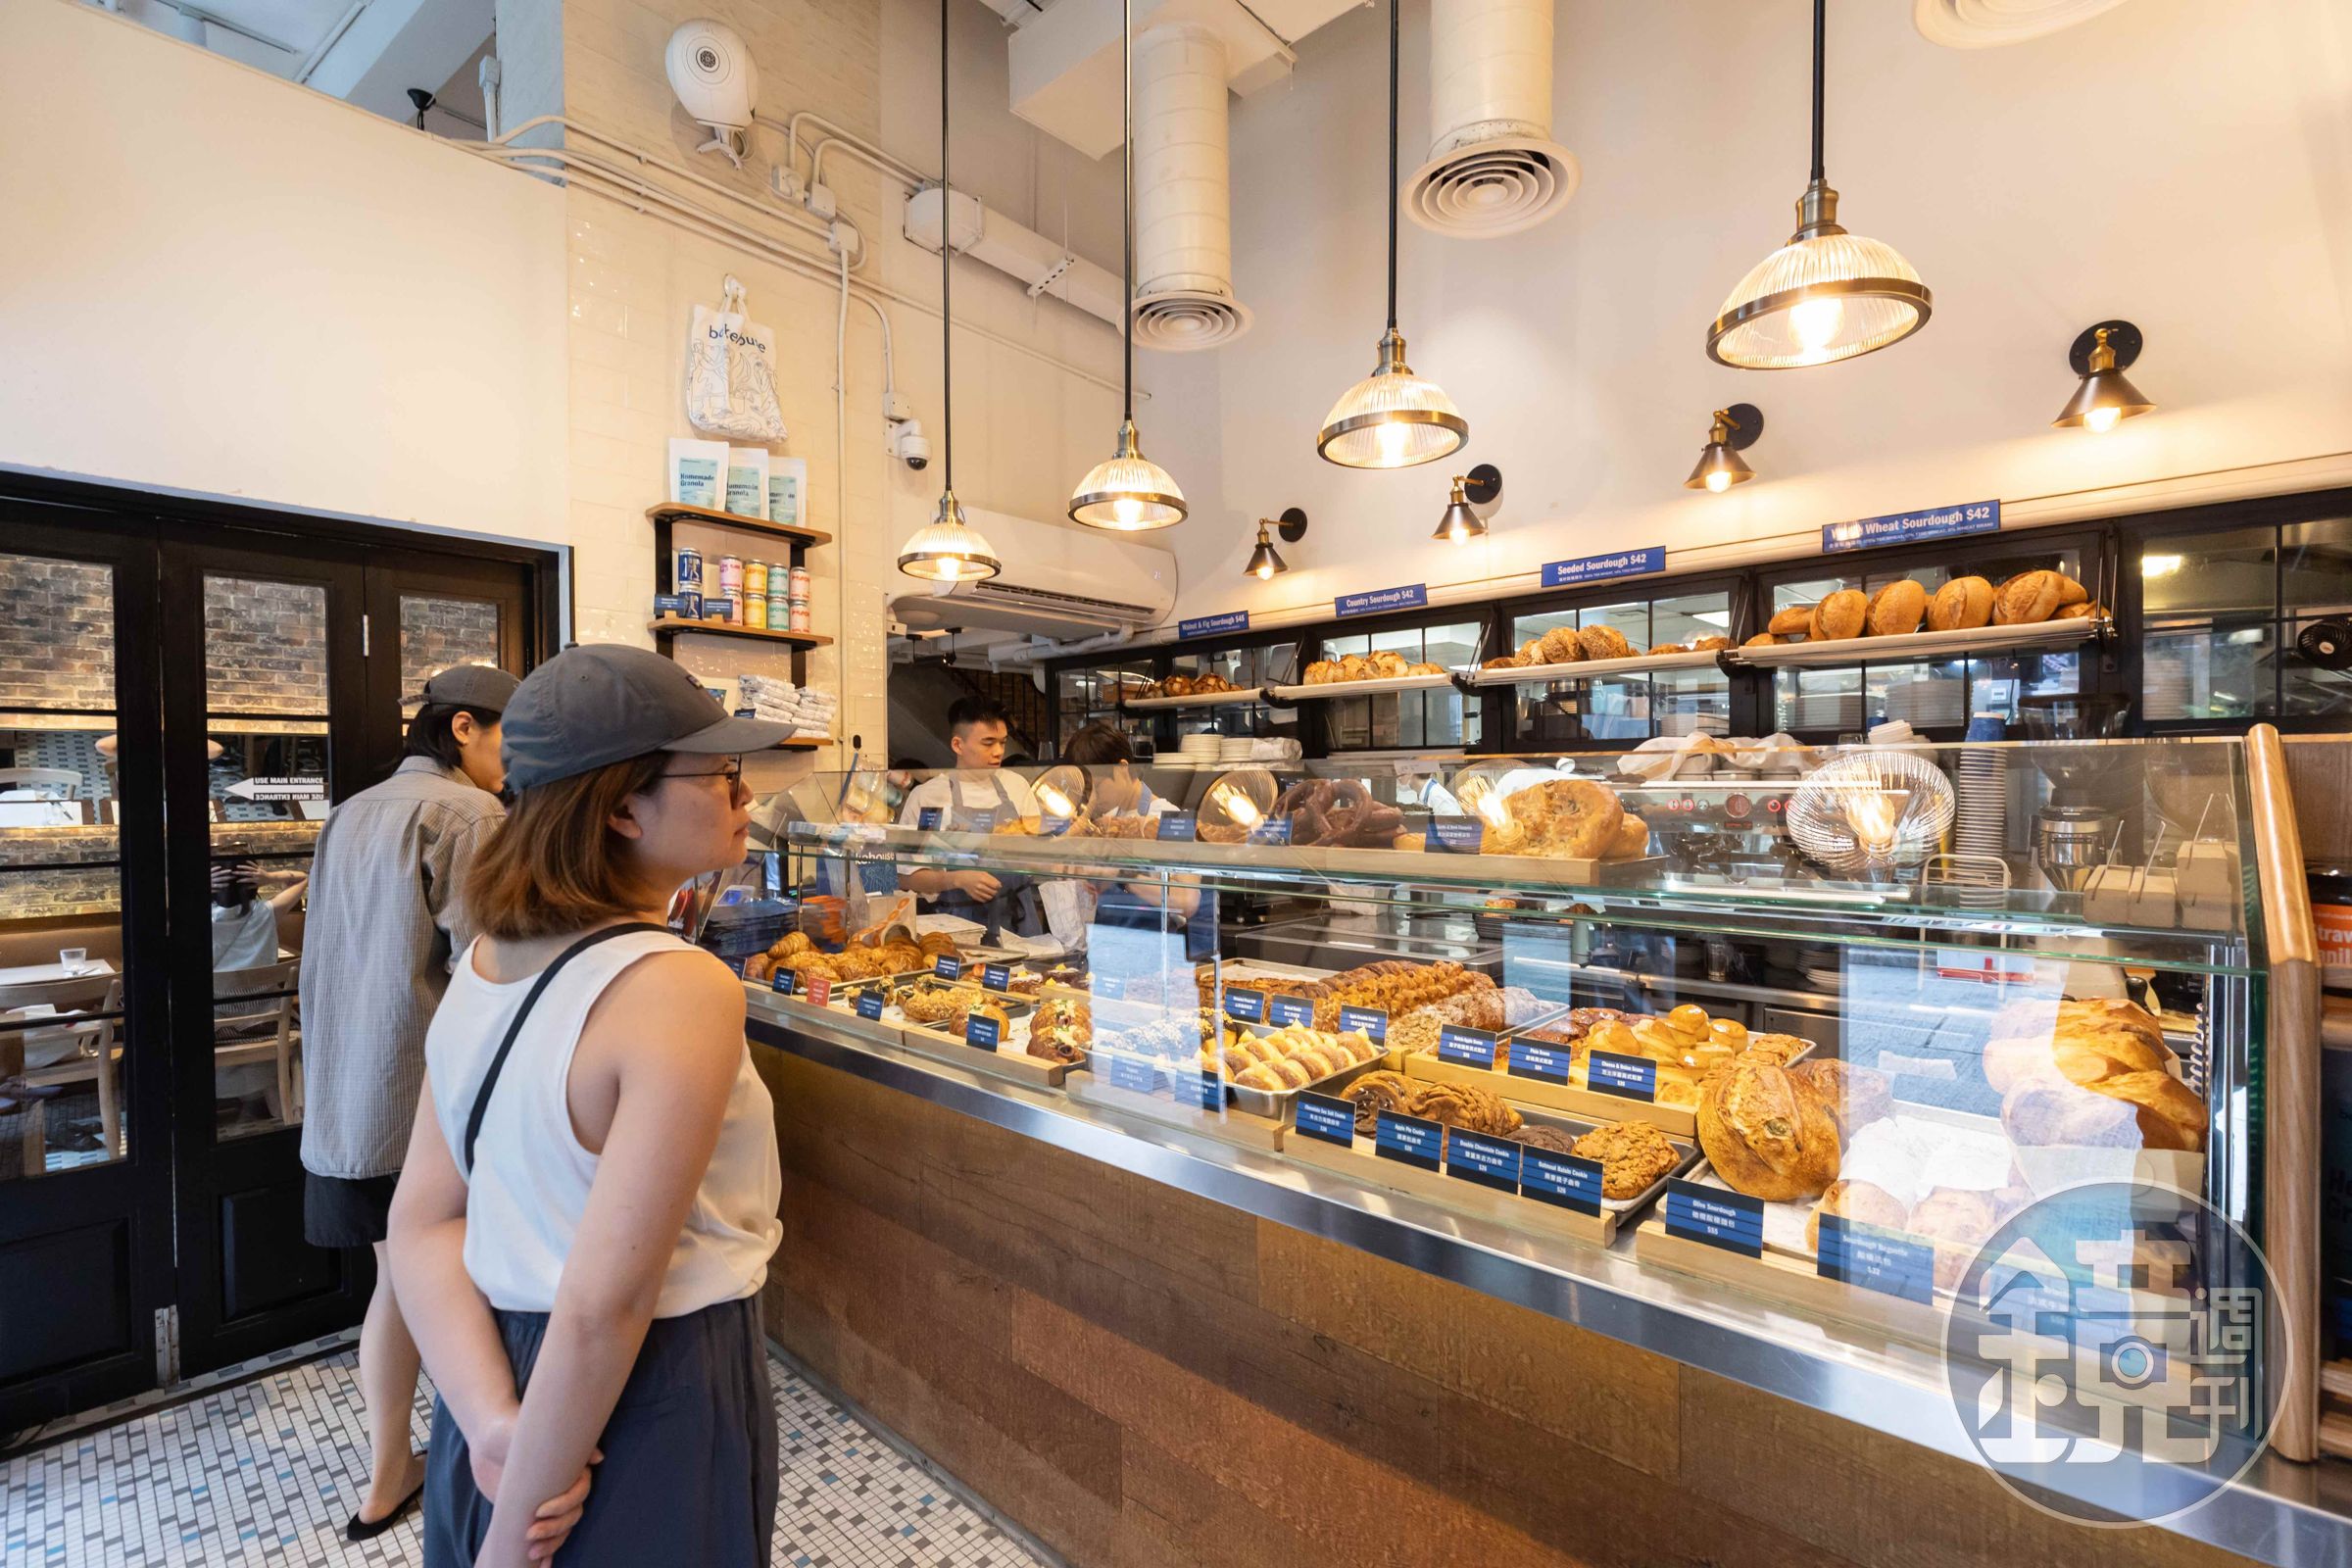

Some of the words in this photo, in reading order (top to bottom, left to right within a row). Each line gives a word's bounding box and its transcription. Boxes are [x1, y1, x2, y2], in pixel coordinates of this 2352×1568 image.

[1865, 520, 1899, 535] Wheat
[1902, 511, 1963, 530] Sourdough
[1966, 507, 1990, 521] $42
[1557, 564, 1585, 575] Seeded
[1586, 556, 1628, 570] Sourdough
[1630, 553, 1647, 564] $42
[1346, 598, 1368, 608] Country
[1369, 592, 1401, 604] Sourdough
[1401, 589, 1414, 600] $42
[1494, 1149, 1510, 1158] Cookie
[1572, 1169, 1589, 1180] Cookie
[1706, 1203, 1737, 1217] Sourdough
